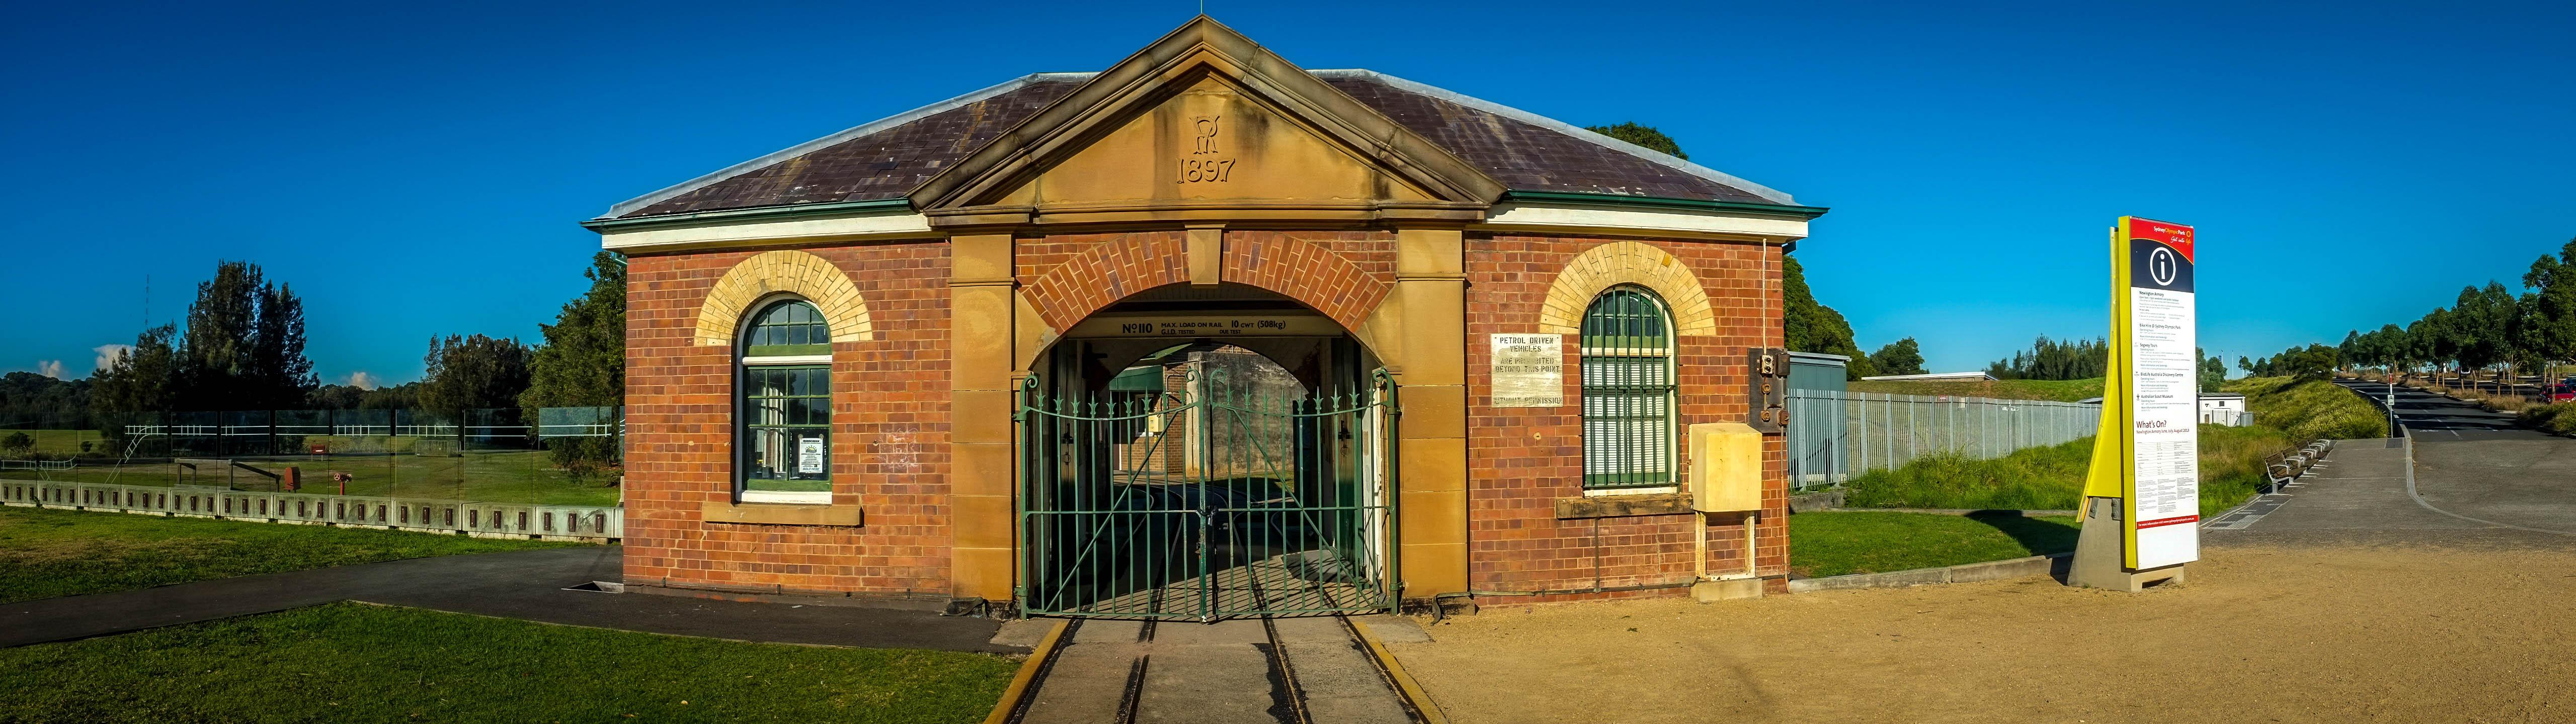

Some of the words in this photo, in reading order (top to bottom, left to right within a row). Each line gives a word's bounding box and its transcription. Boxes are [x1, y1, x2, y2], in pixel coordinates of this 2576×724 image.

[1175, 158, 1236, 184] 1897
[1232, 320, 1239, 328] 10
[1257, 320, 1286, 330] (508kg)
